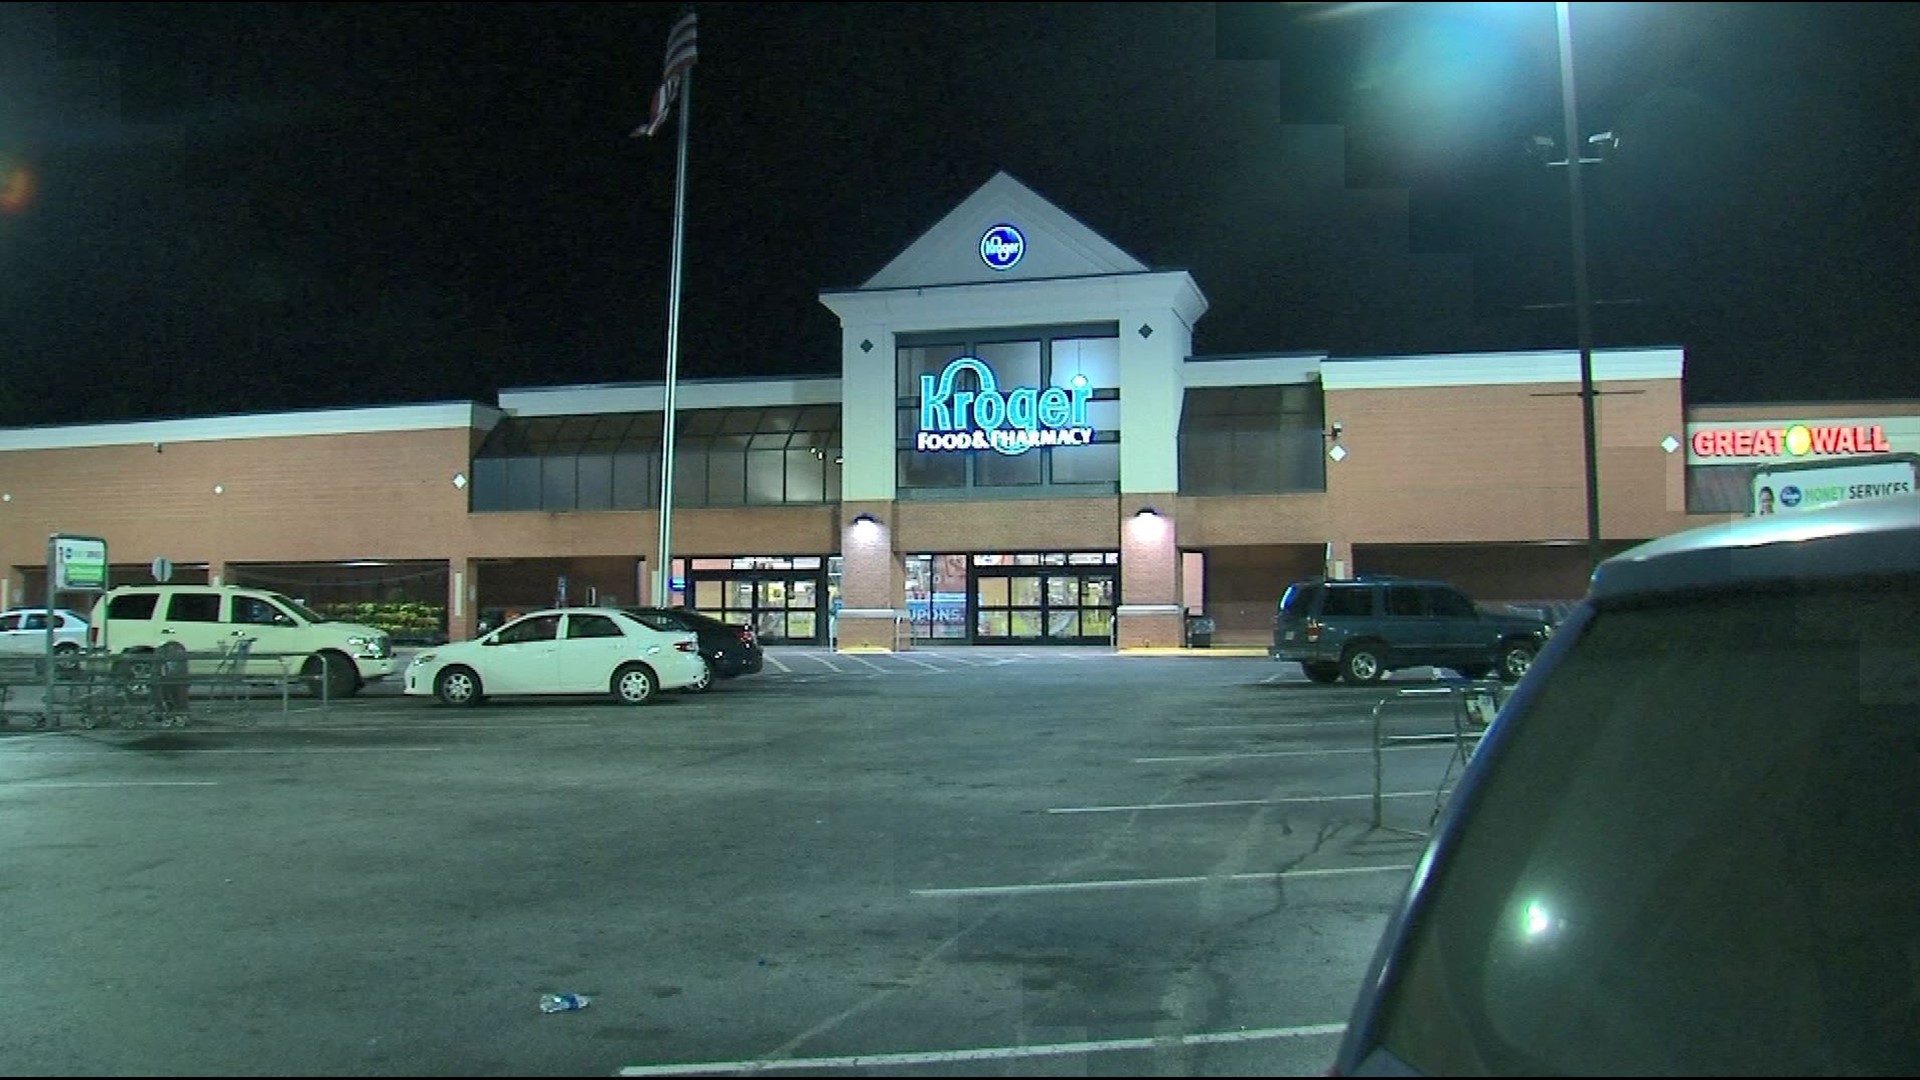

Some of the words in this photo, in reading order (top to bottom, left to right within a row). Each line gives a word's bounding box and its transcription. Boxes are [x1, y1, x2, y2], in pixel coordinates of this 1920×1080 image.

[920, 358, 1092, 455] Kroger
[989, 428, 1092, 449] PHARMACY
[1693, 431, 1786, 456] GREAT
[1811, 426, 1890, 455] WALL
[1805, 487, 1846, 502] MONEY
[1849, 482, 1909, 499] SERVICES
